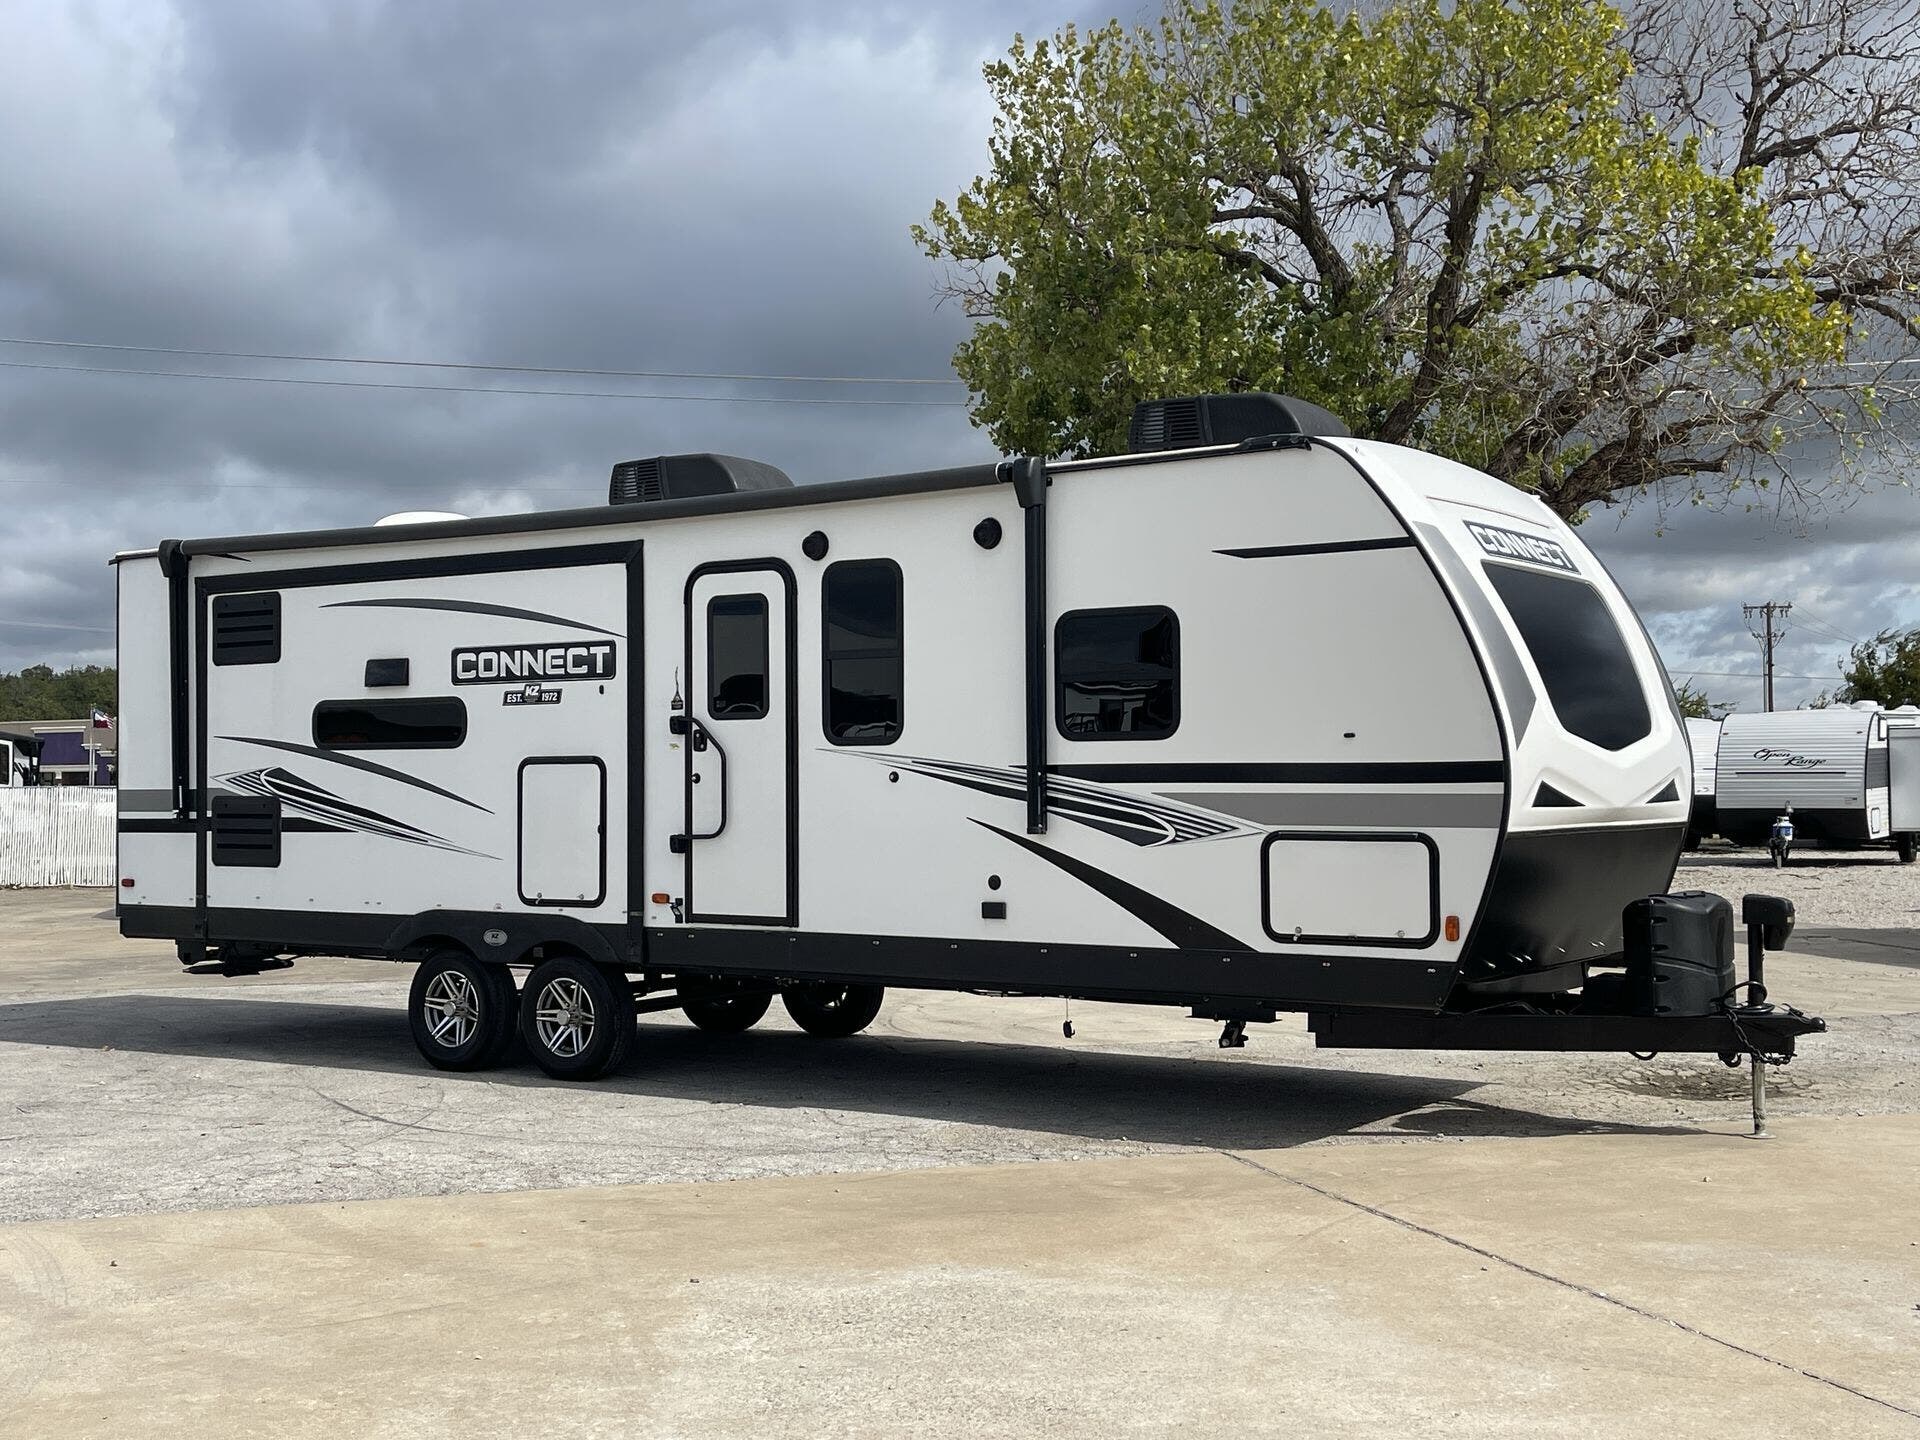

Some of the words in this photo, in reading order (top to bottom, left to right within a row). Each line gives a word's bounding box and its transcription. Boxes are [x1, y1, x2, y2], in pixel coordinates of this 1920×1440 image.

[1468, 524, 1574, 569] CONNECT
[456, 645, 611, 680] CONNECT
[506, 693, 523, 703] EST.
[541, 692, 558, 702] 1972
[525, 685, 540, 697] KZ
[1753, 748, 1791, 761] Open
[1783, 756, 1827, 769] Range
